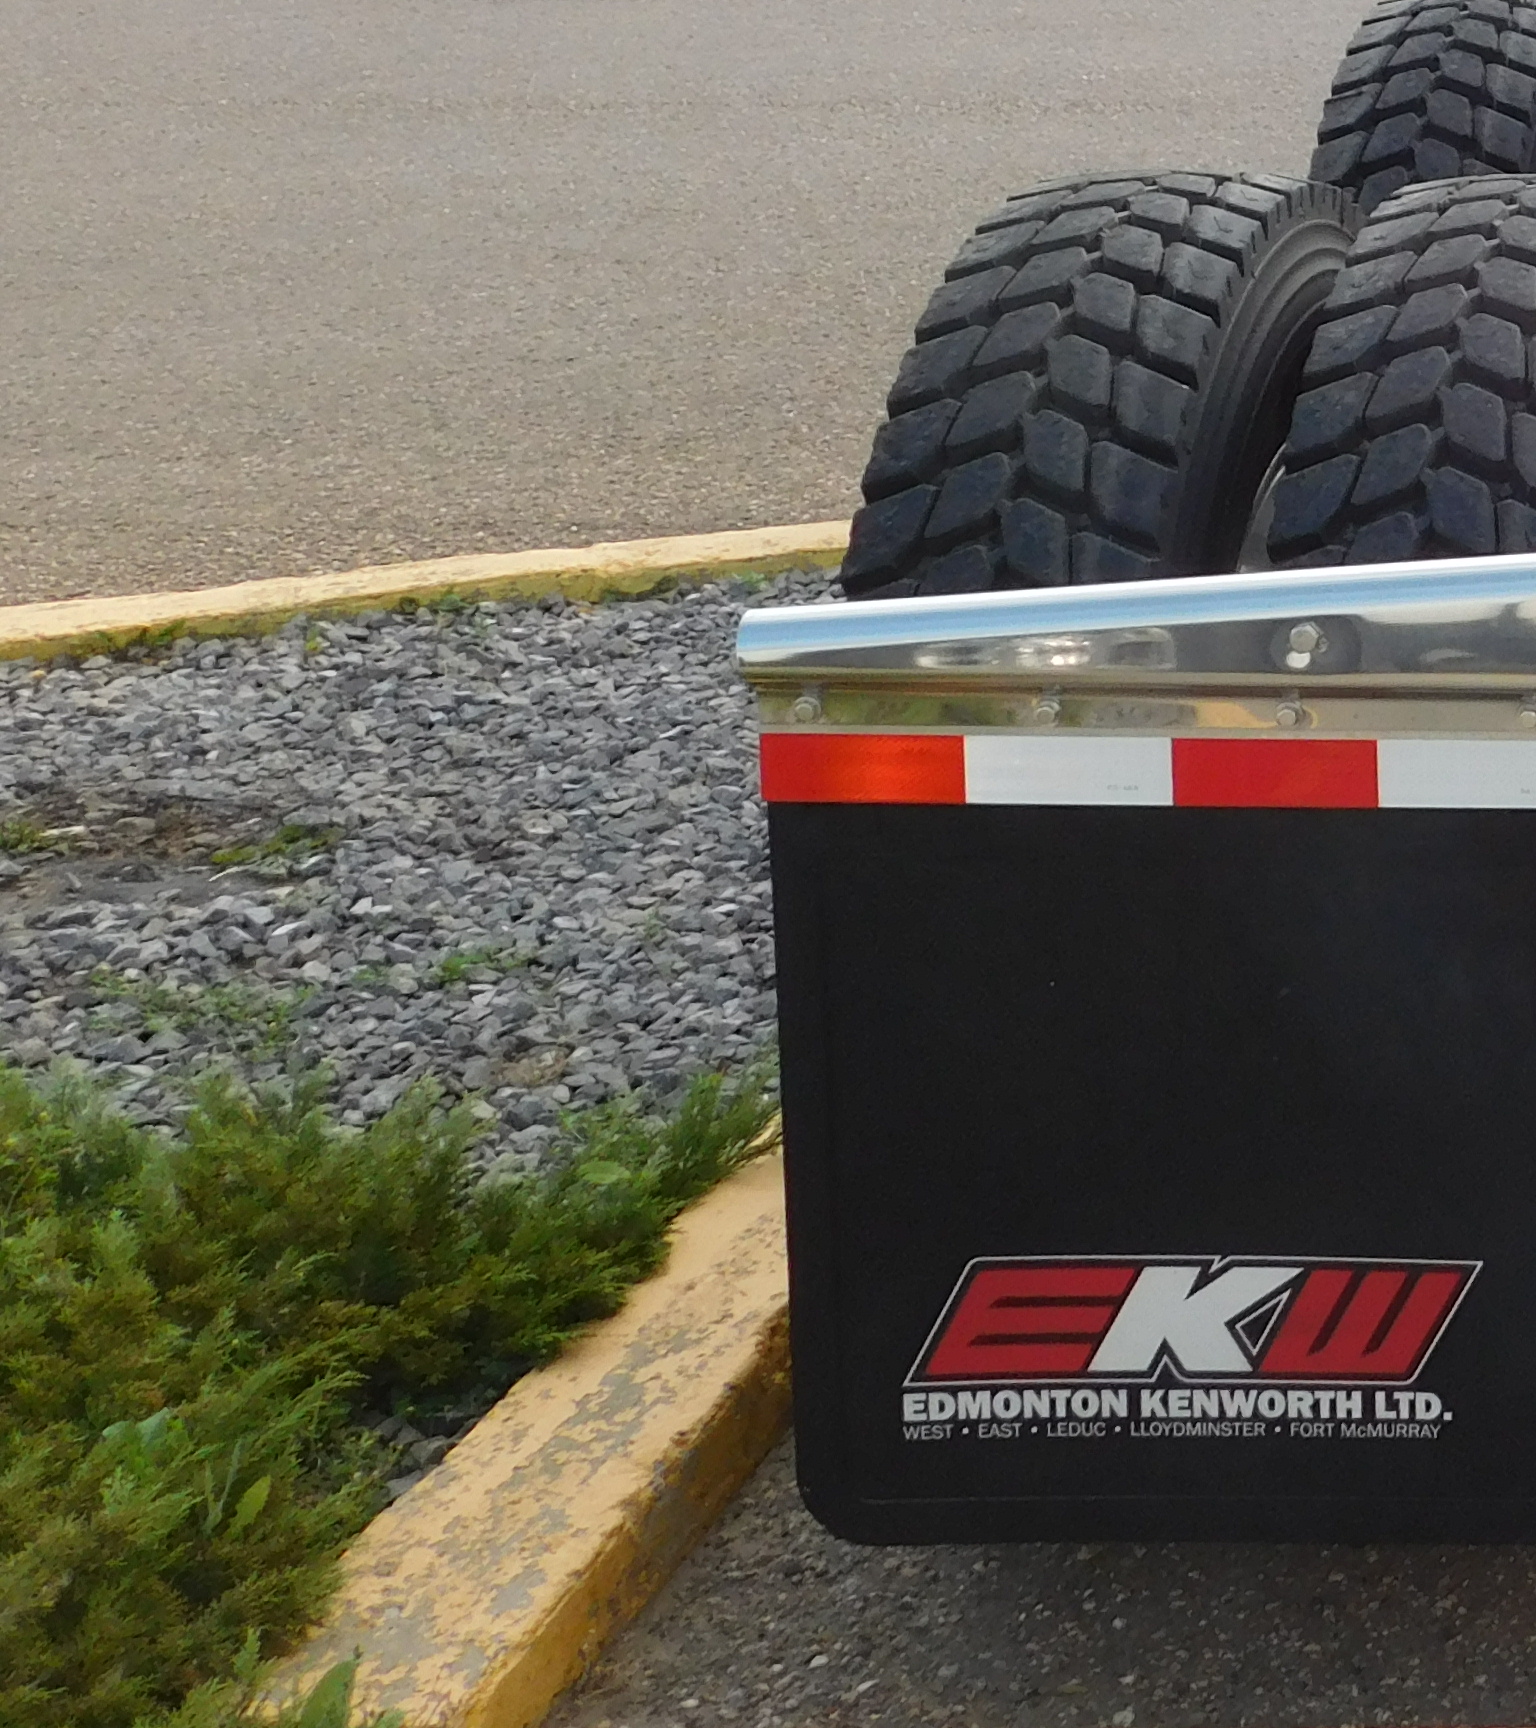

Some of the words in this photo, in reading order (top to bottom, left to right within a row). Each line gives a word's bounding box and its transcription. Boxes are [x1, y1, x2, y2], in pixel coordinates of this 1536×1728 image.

[925, 1266, 1461, 1376] EKW
[902, 1389, 1128, 1422] EDMONTON
[1140, 1388, 1362, 1419] KENWORTH
[1375, 1390, 1453, 1421] LTD.
[902, 1424, 953, 1440] WEST
[978, 1423, 1023, 1438] EAST
[1047, 1422, 1106, 1437] LEDUC
[1130, 1422, 1266, 1437] LLOYDMINSTER
[1290, 1422, 1335, 1437] FORT
[1341, 1423, 1442, 1439] McMURRAY
